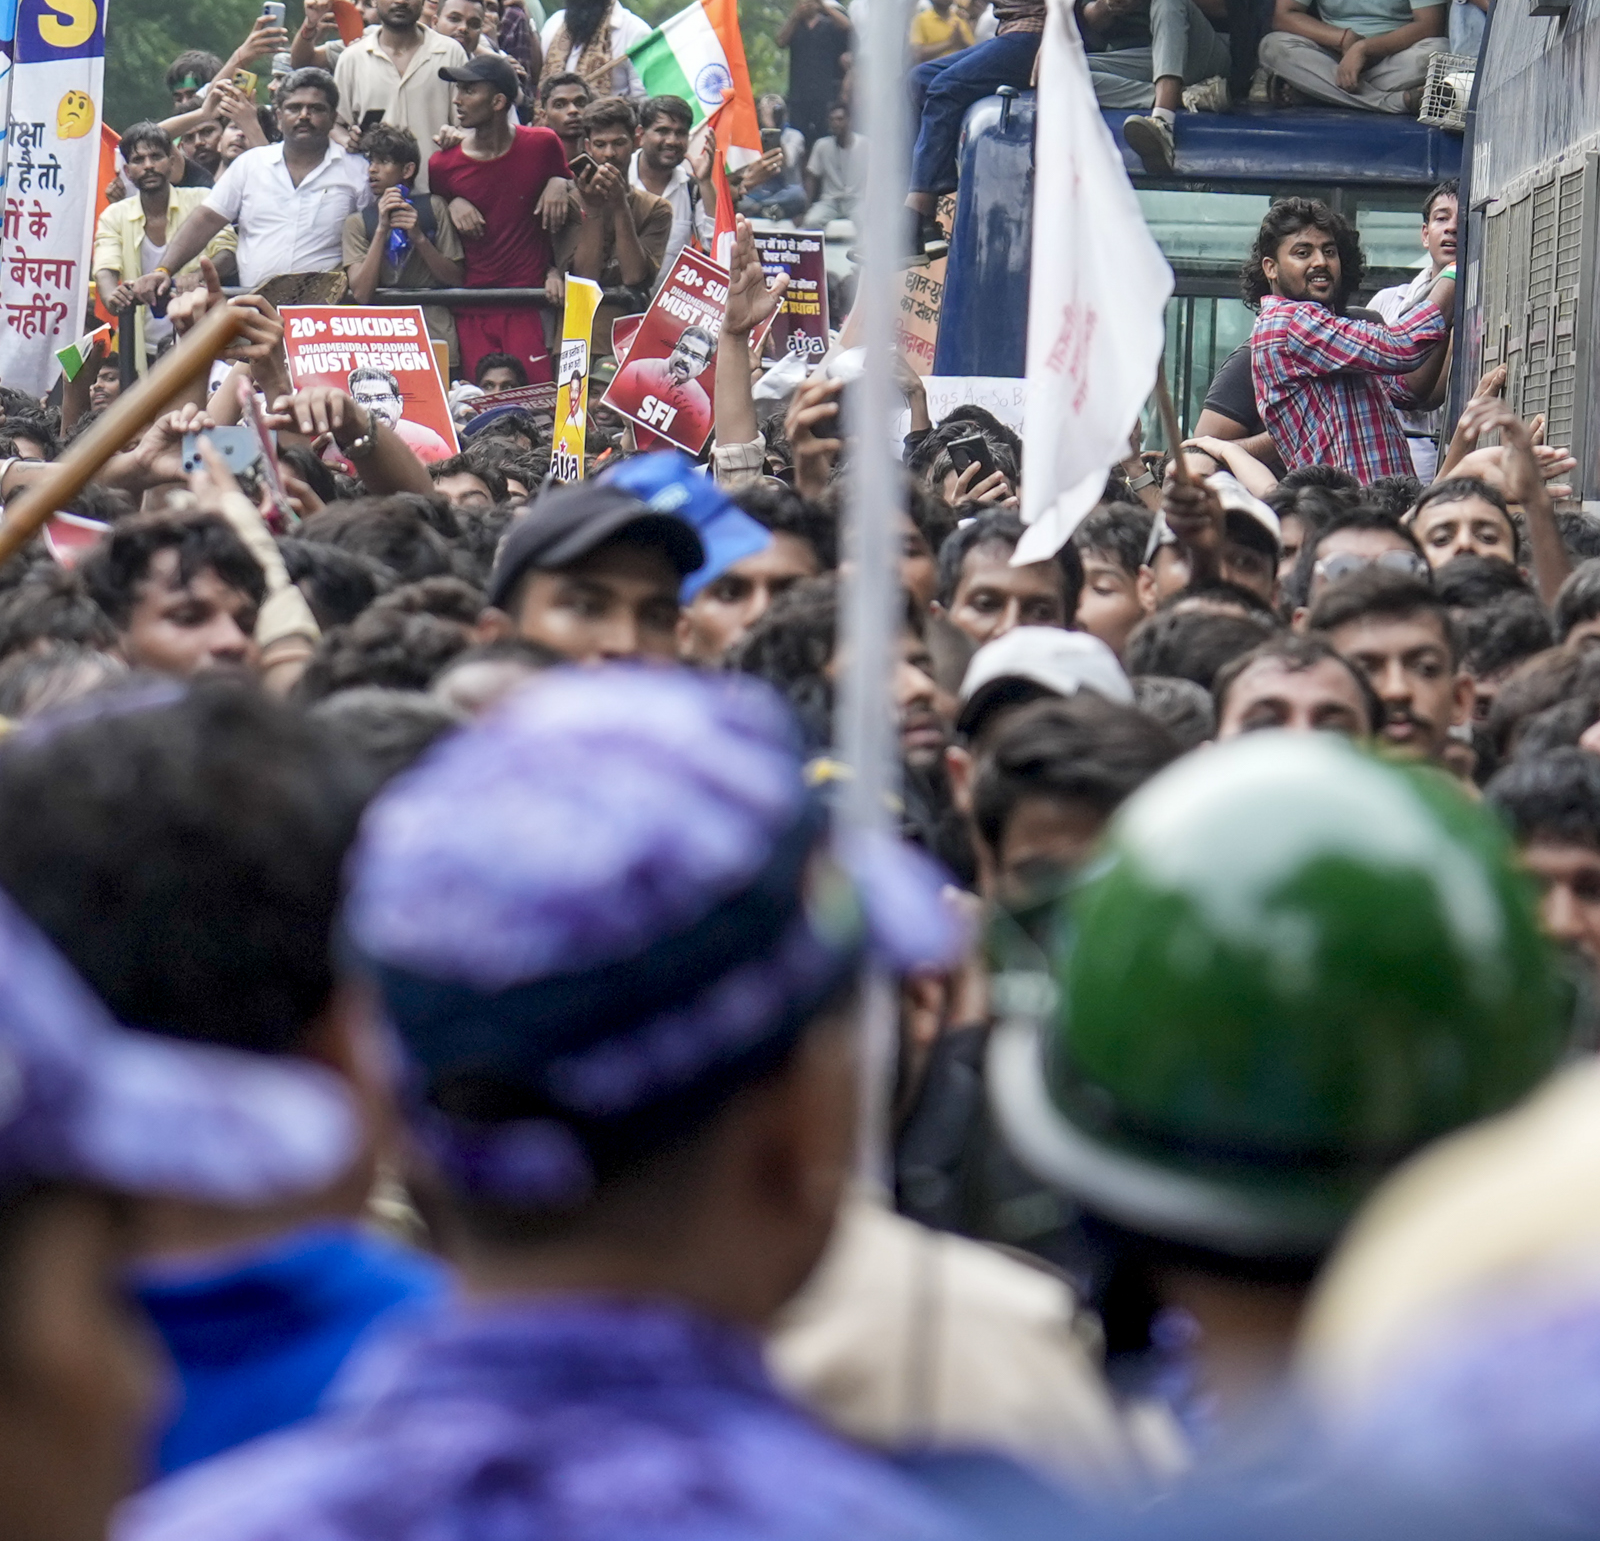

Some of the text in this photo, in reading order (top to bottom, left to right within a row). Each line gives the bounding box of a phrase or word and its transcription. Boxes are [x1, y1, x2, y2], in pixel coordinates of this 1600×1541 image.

[28, 199, 52, 241] के
[9, 246, 77, 291] बेचना
[675, 264, 704, 287] 20+
[5, 293, 68, 339] नहीं?
[657, 291, 702, 325] MUST
[670, 286, 720, 319] DHARMENDRA
[290, 317, 419, 338] 20+ SUICIDES
[294, 352, 430, 376] MUST RESIGN
[298, 342, 420, 355] DHARMENDRA PRADHAN
[637, 395, 678, 433] SFI
[550, 451, 579, 482] aisa
